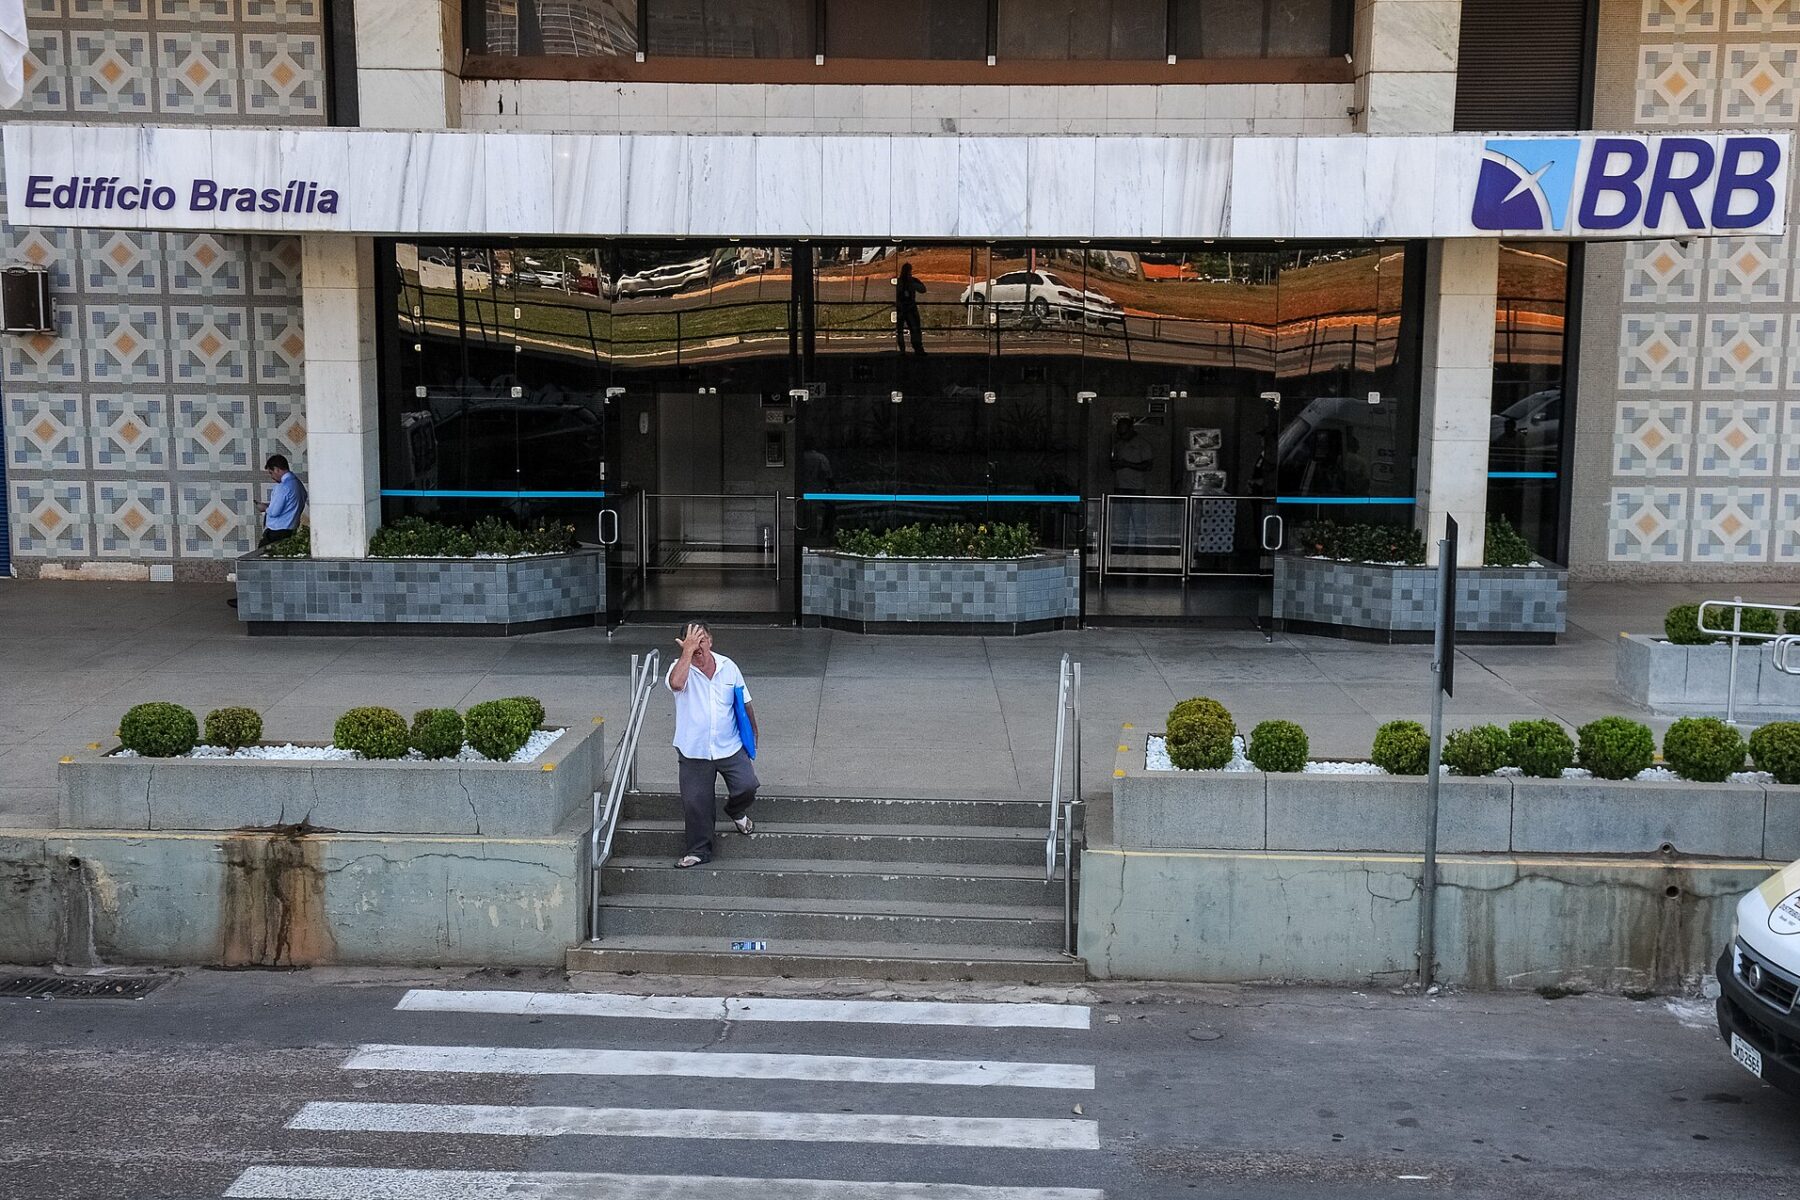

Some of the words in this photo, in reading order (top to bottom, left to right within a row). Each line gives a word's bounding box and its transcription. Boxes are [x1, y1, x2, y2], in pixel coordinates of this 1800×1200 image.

[24, 175, 176, 211] Edifício
[189, 179, 339, 214] Brasília
[1578, 137, 1781, 229] BRB
